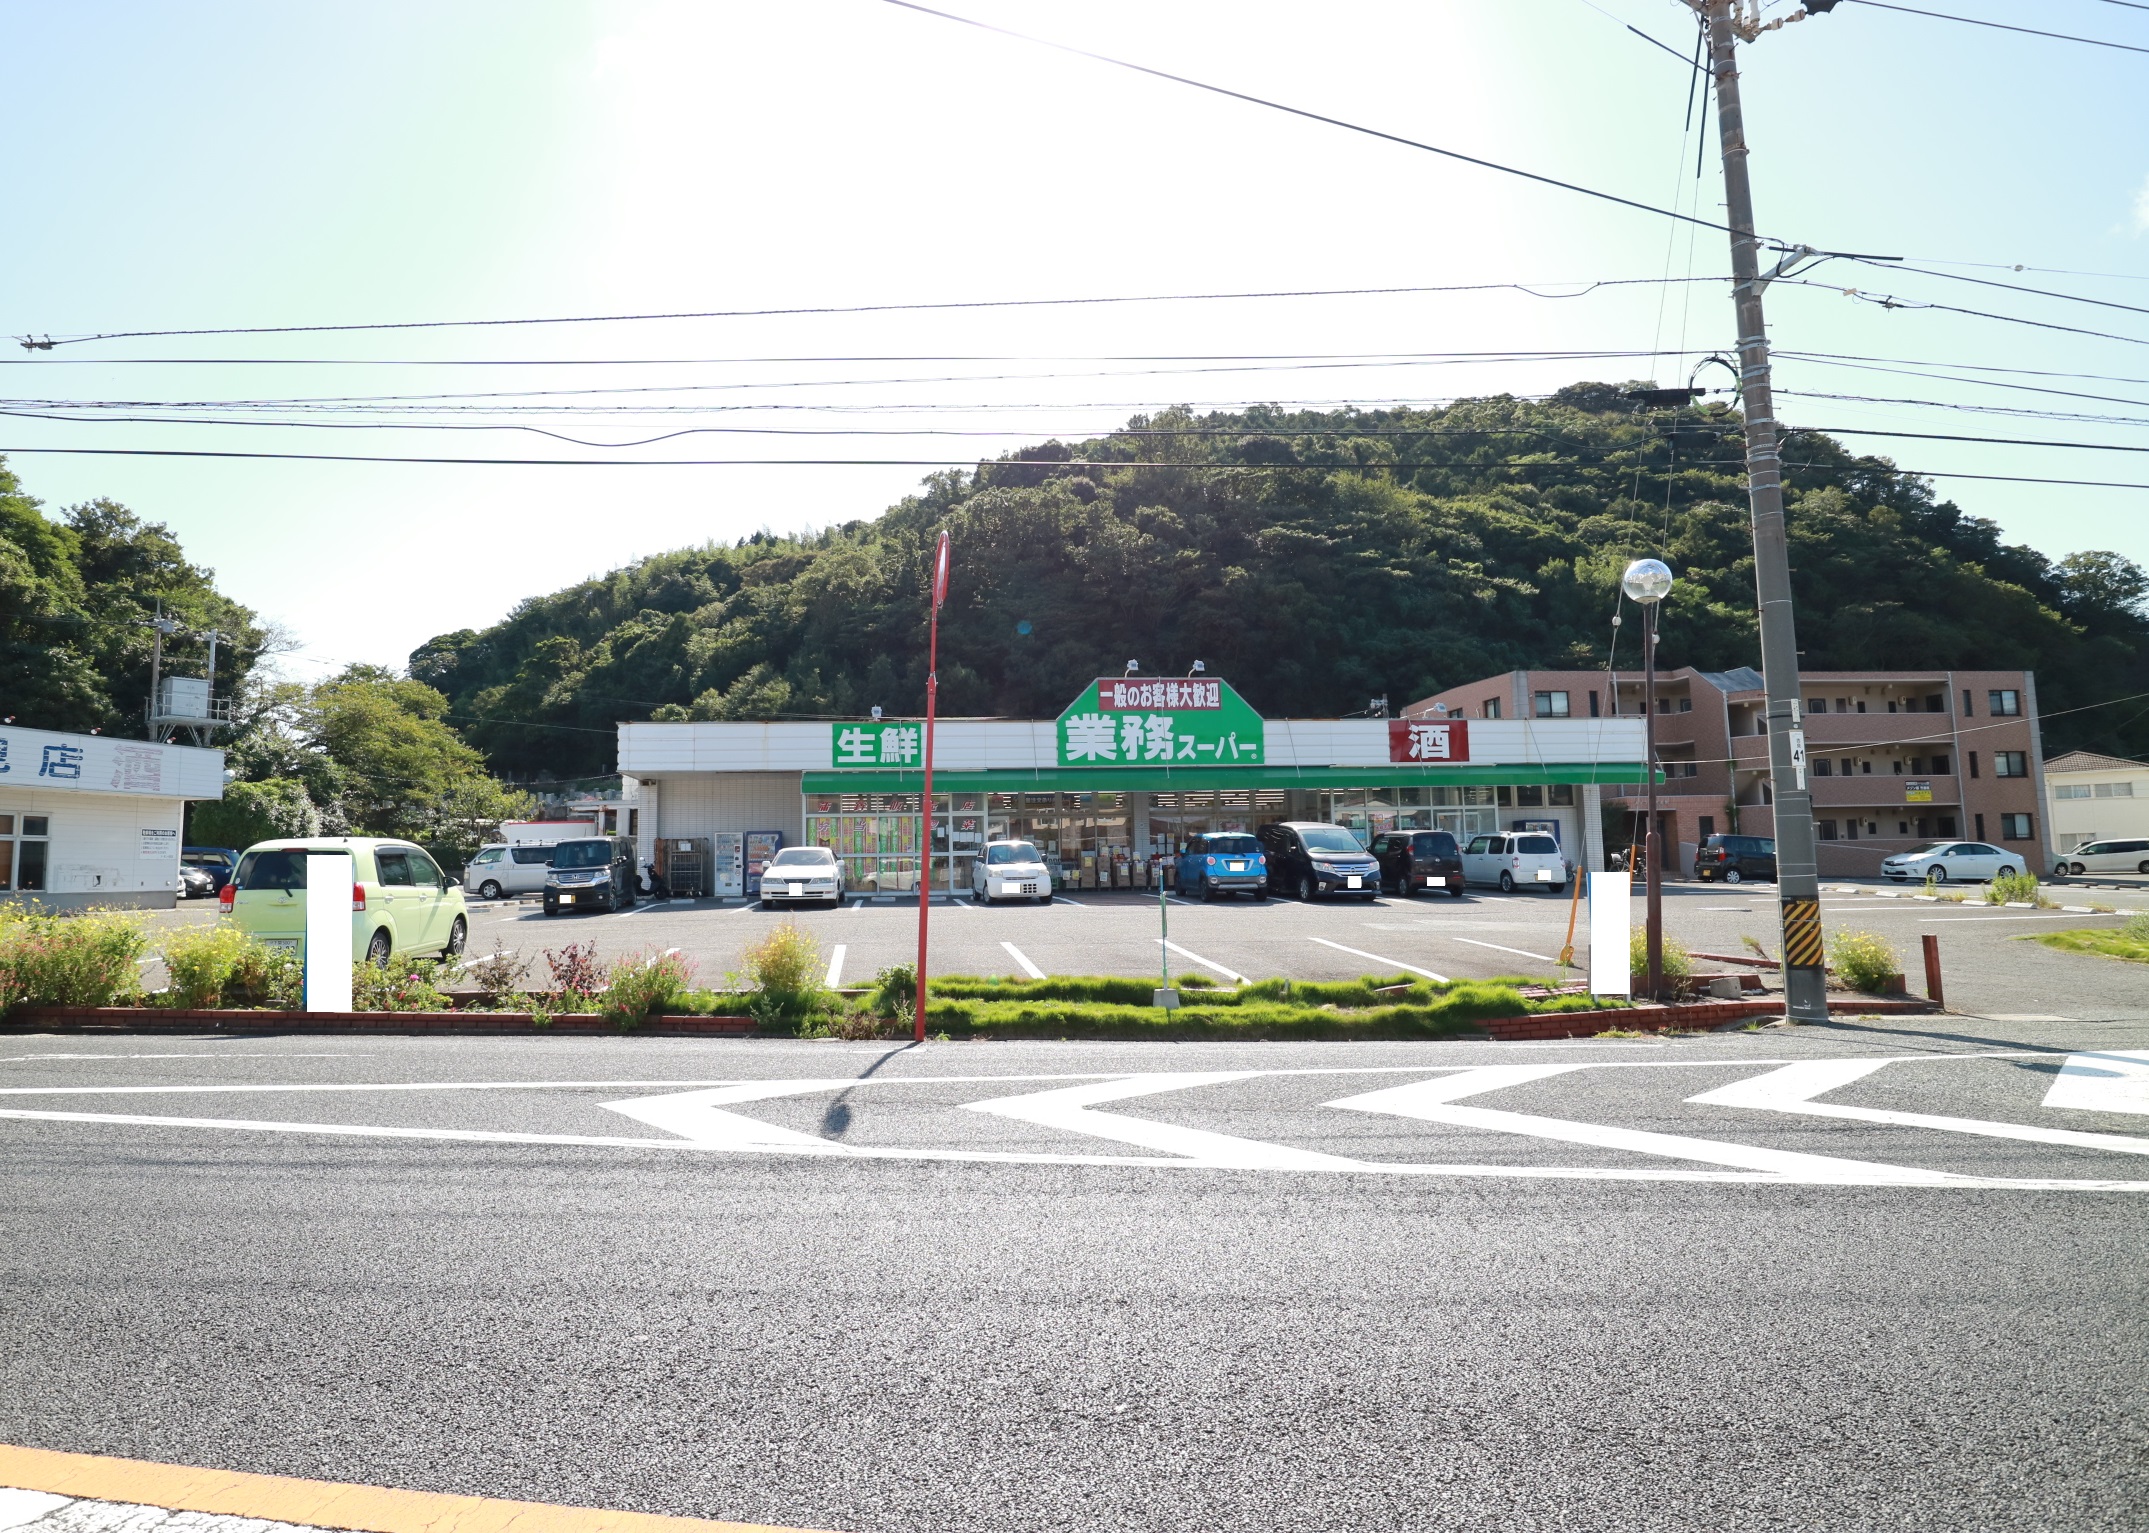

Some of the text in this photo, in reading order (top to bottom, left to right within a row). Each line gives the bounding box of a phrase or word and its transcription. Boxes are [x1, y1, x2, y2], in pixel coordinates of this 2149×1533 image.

[1100, 682, 1220, 708] 一般のお客様大歓迎
[837, 727, 918, 764] 生鮮
[1065, 713, 1257, 761] 業務スーパー
[1408, 724, 1450, 759] 酒
[110, 743, 164, 791] 酒
[1793, 749, 1804, 763] 41
